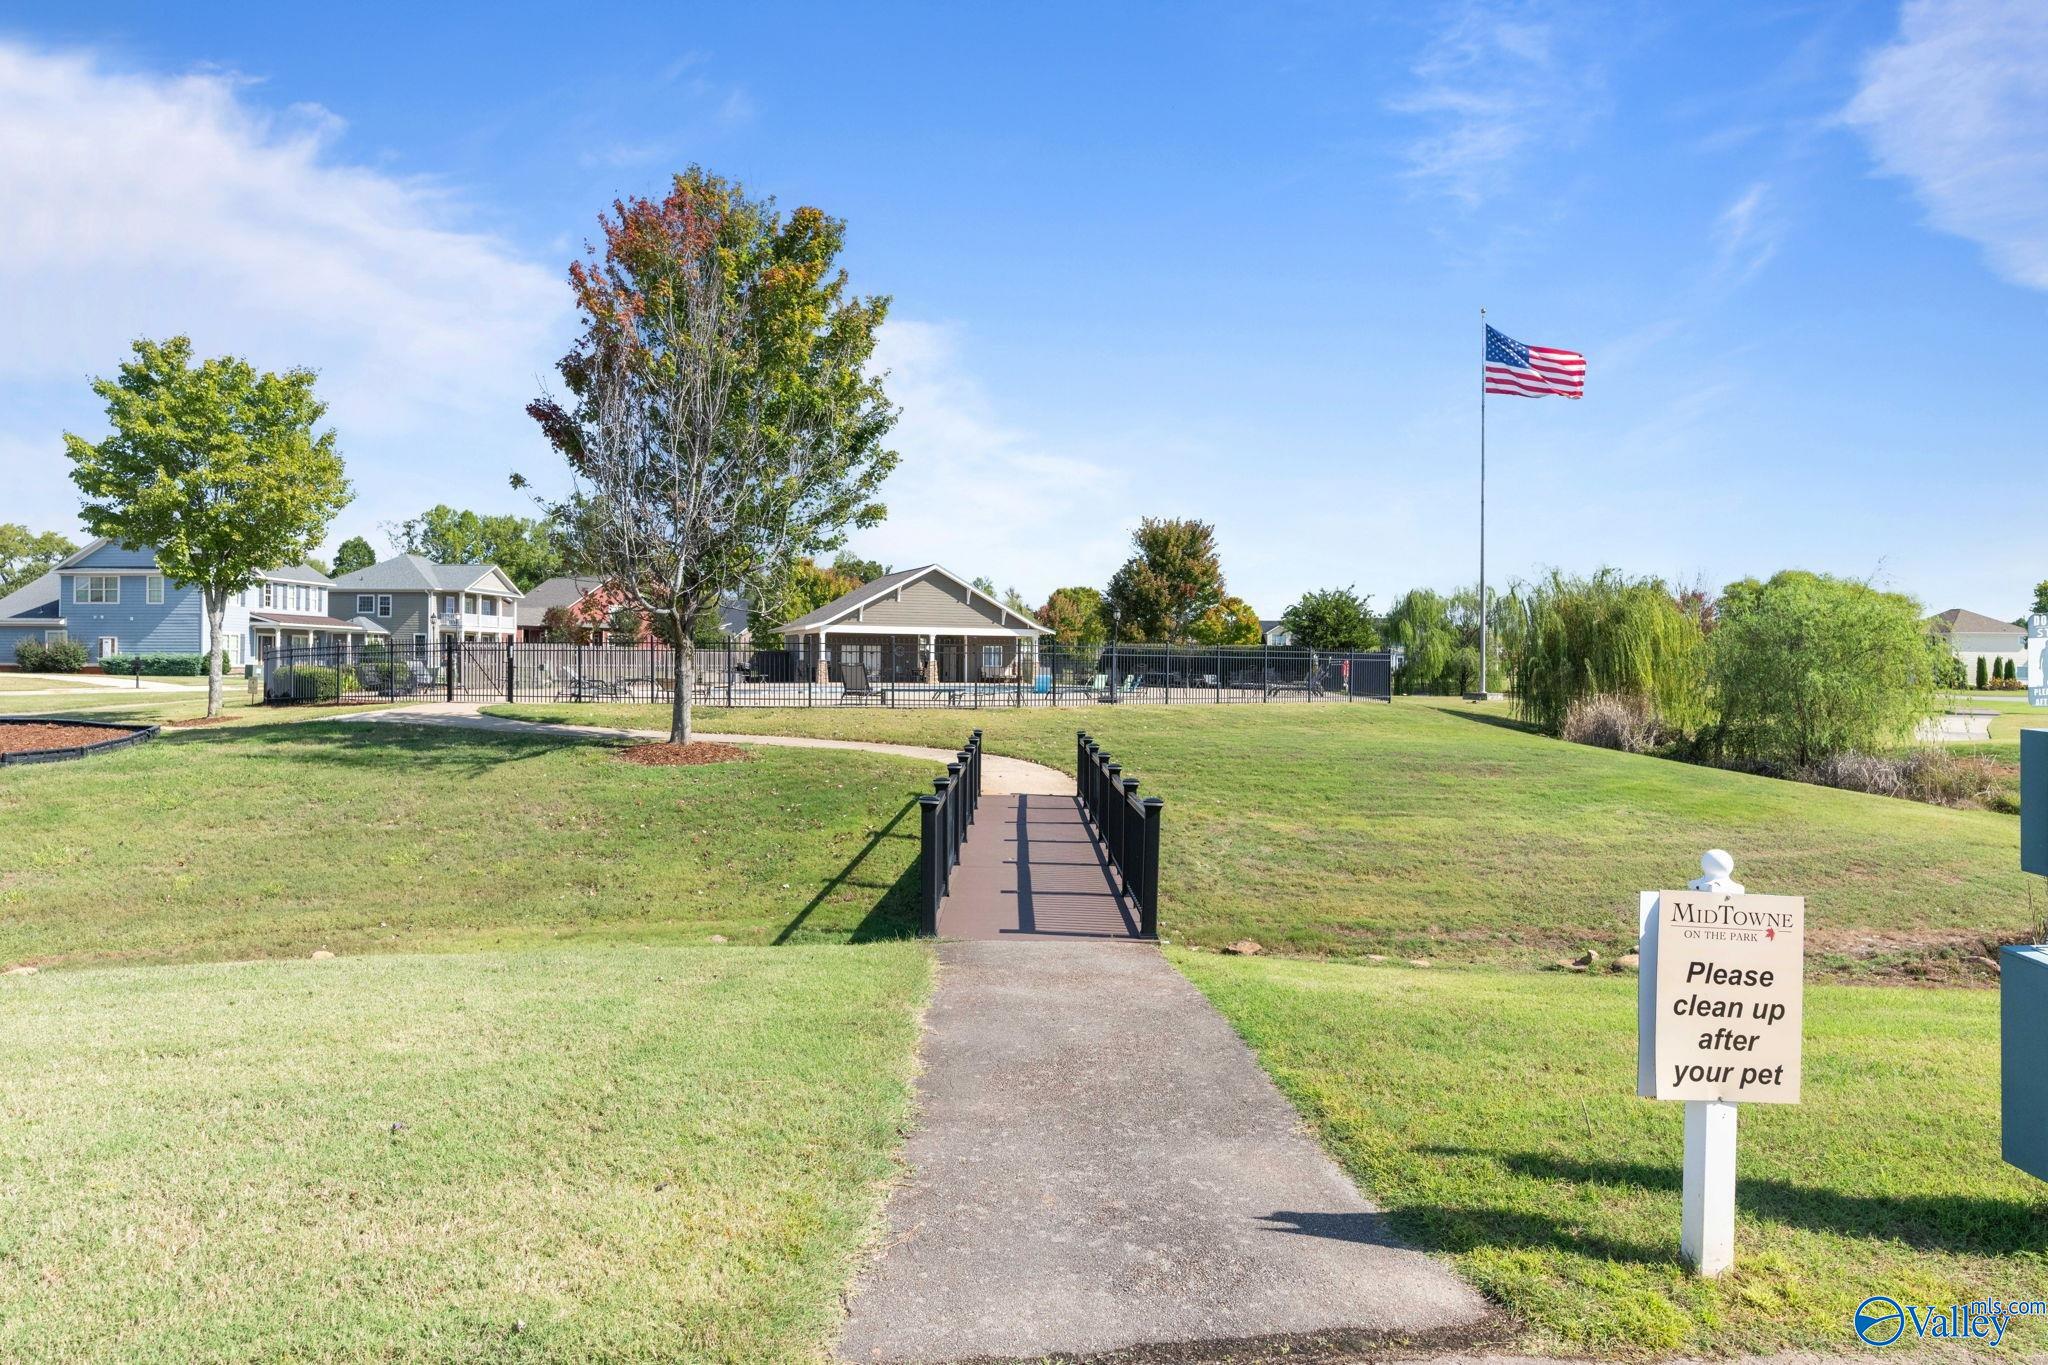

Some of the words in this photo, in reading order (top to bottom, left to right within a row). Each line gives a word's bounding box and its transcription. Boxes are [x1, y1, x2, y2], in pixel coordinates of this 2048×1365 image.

[1684, 929, 1701, 939] ON
[1705, 930, 1727, 941] THE
[1730, 932, 1758, 942] PARK
[1686, 961, 1774, 987] Please
[1673, 994, 1743, 1018] clean
[1752, 1002, 1785, 1025] up
[1698, 1028, 1760, 1051] after
[1672, 1064, 1734, 1087] your
[1739, 1064, 1783, 1089] pet
